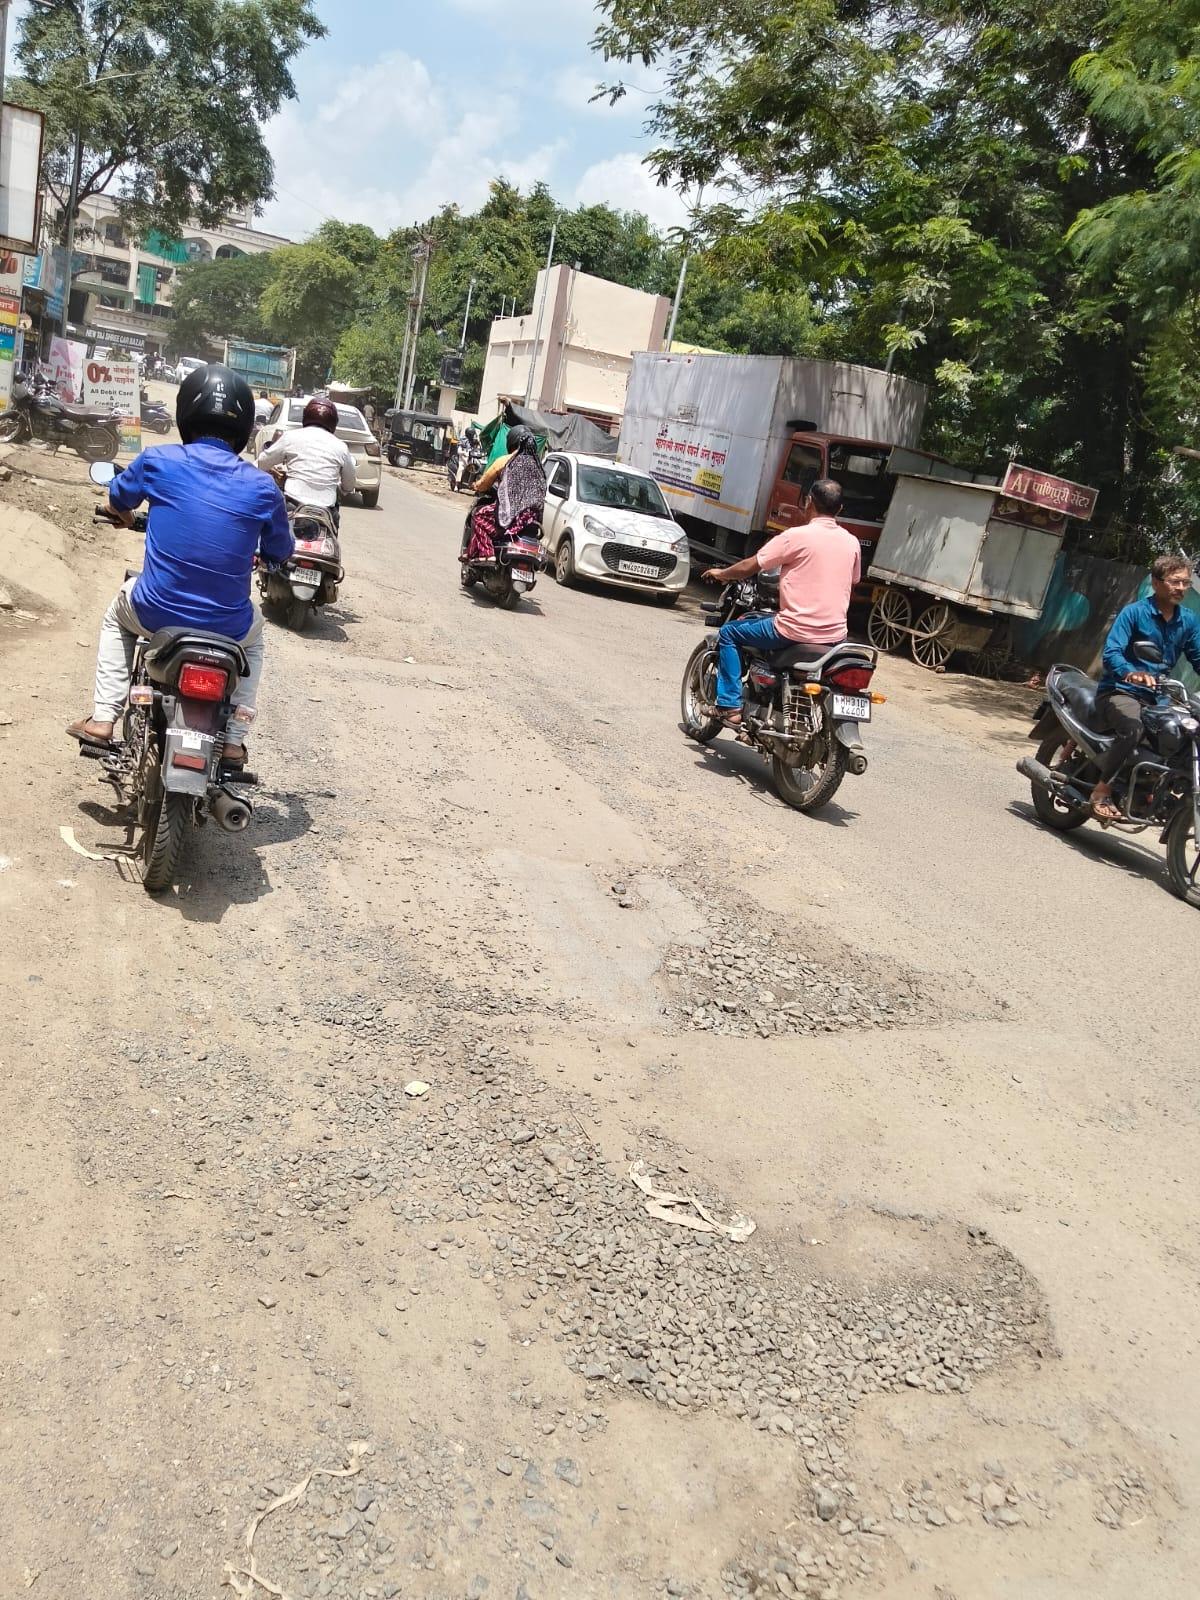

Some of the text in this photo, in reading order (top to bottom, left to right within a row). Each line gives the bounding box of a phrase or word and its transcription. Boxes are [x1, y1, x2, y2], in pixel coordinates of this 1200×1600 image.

[86, 329, 96, 338] NEW
[120, 335, 129, 345] CAR
[130, 337, 145, 348] BAZAR
[87, 362, 112, 384] 0%
